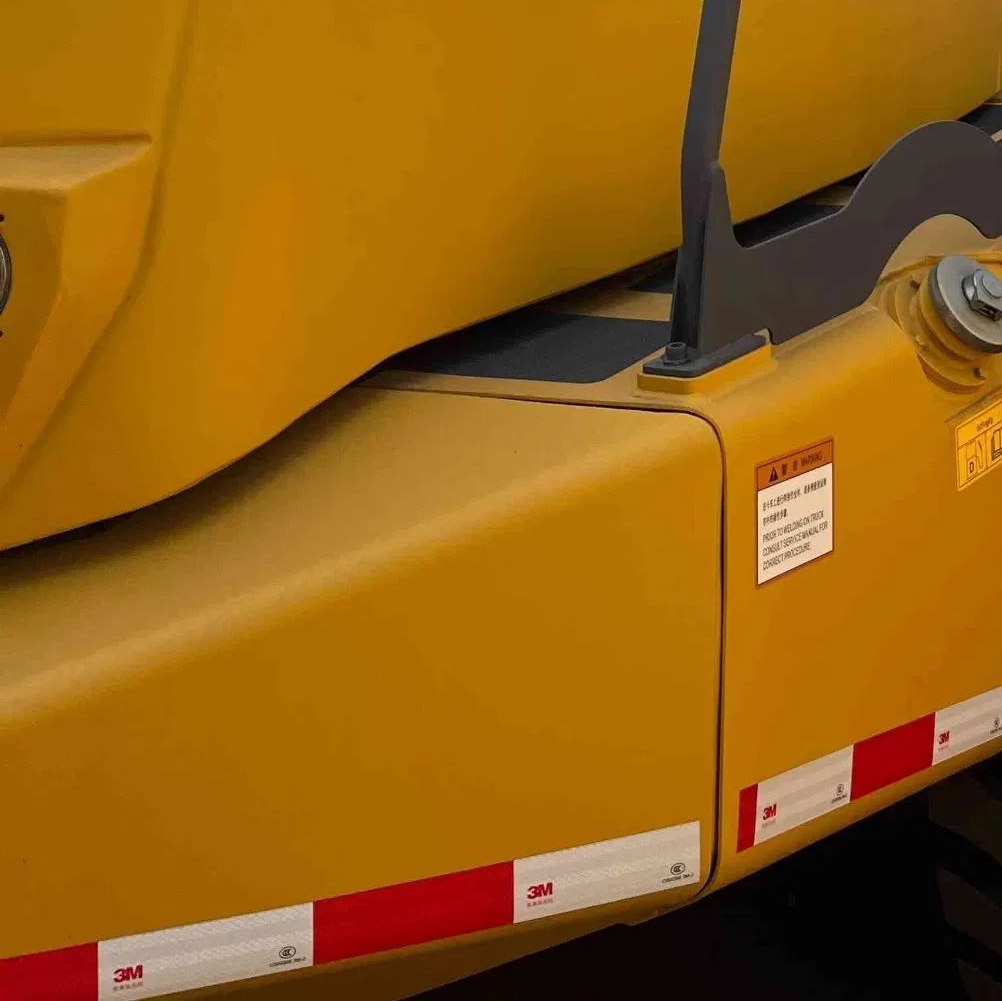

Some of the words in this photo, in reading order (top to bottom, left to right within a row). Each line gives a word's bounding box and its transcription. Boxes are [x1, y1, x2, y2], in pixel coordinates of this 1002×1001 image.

[938, 730, 950, 745] 3M
[762, 803, 777, 821] 3M
[527, 882, 553, 899] 3M
[113, 964, 143, 983] 3M
